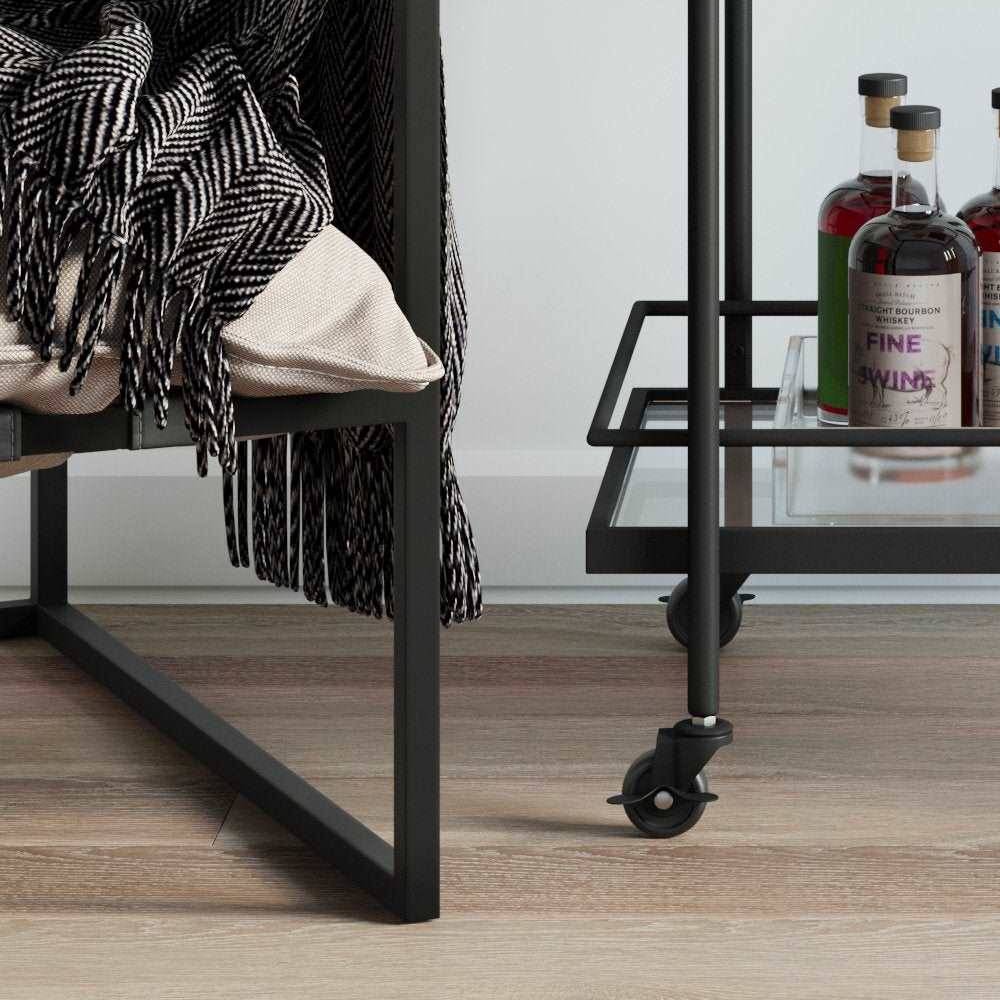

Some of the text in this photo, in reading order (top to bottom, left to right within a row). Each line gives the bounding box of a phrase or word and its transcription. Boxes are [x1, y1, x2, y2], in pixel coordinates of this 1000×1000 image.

[895, 306, 942, 316] BOURBON
[875, 315, 916, 325] WHISKEY
[866, 331, 922, 353] FINE
